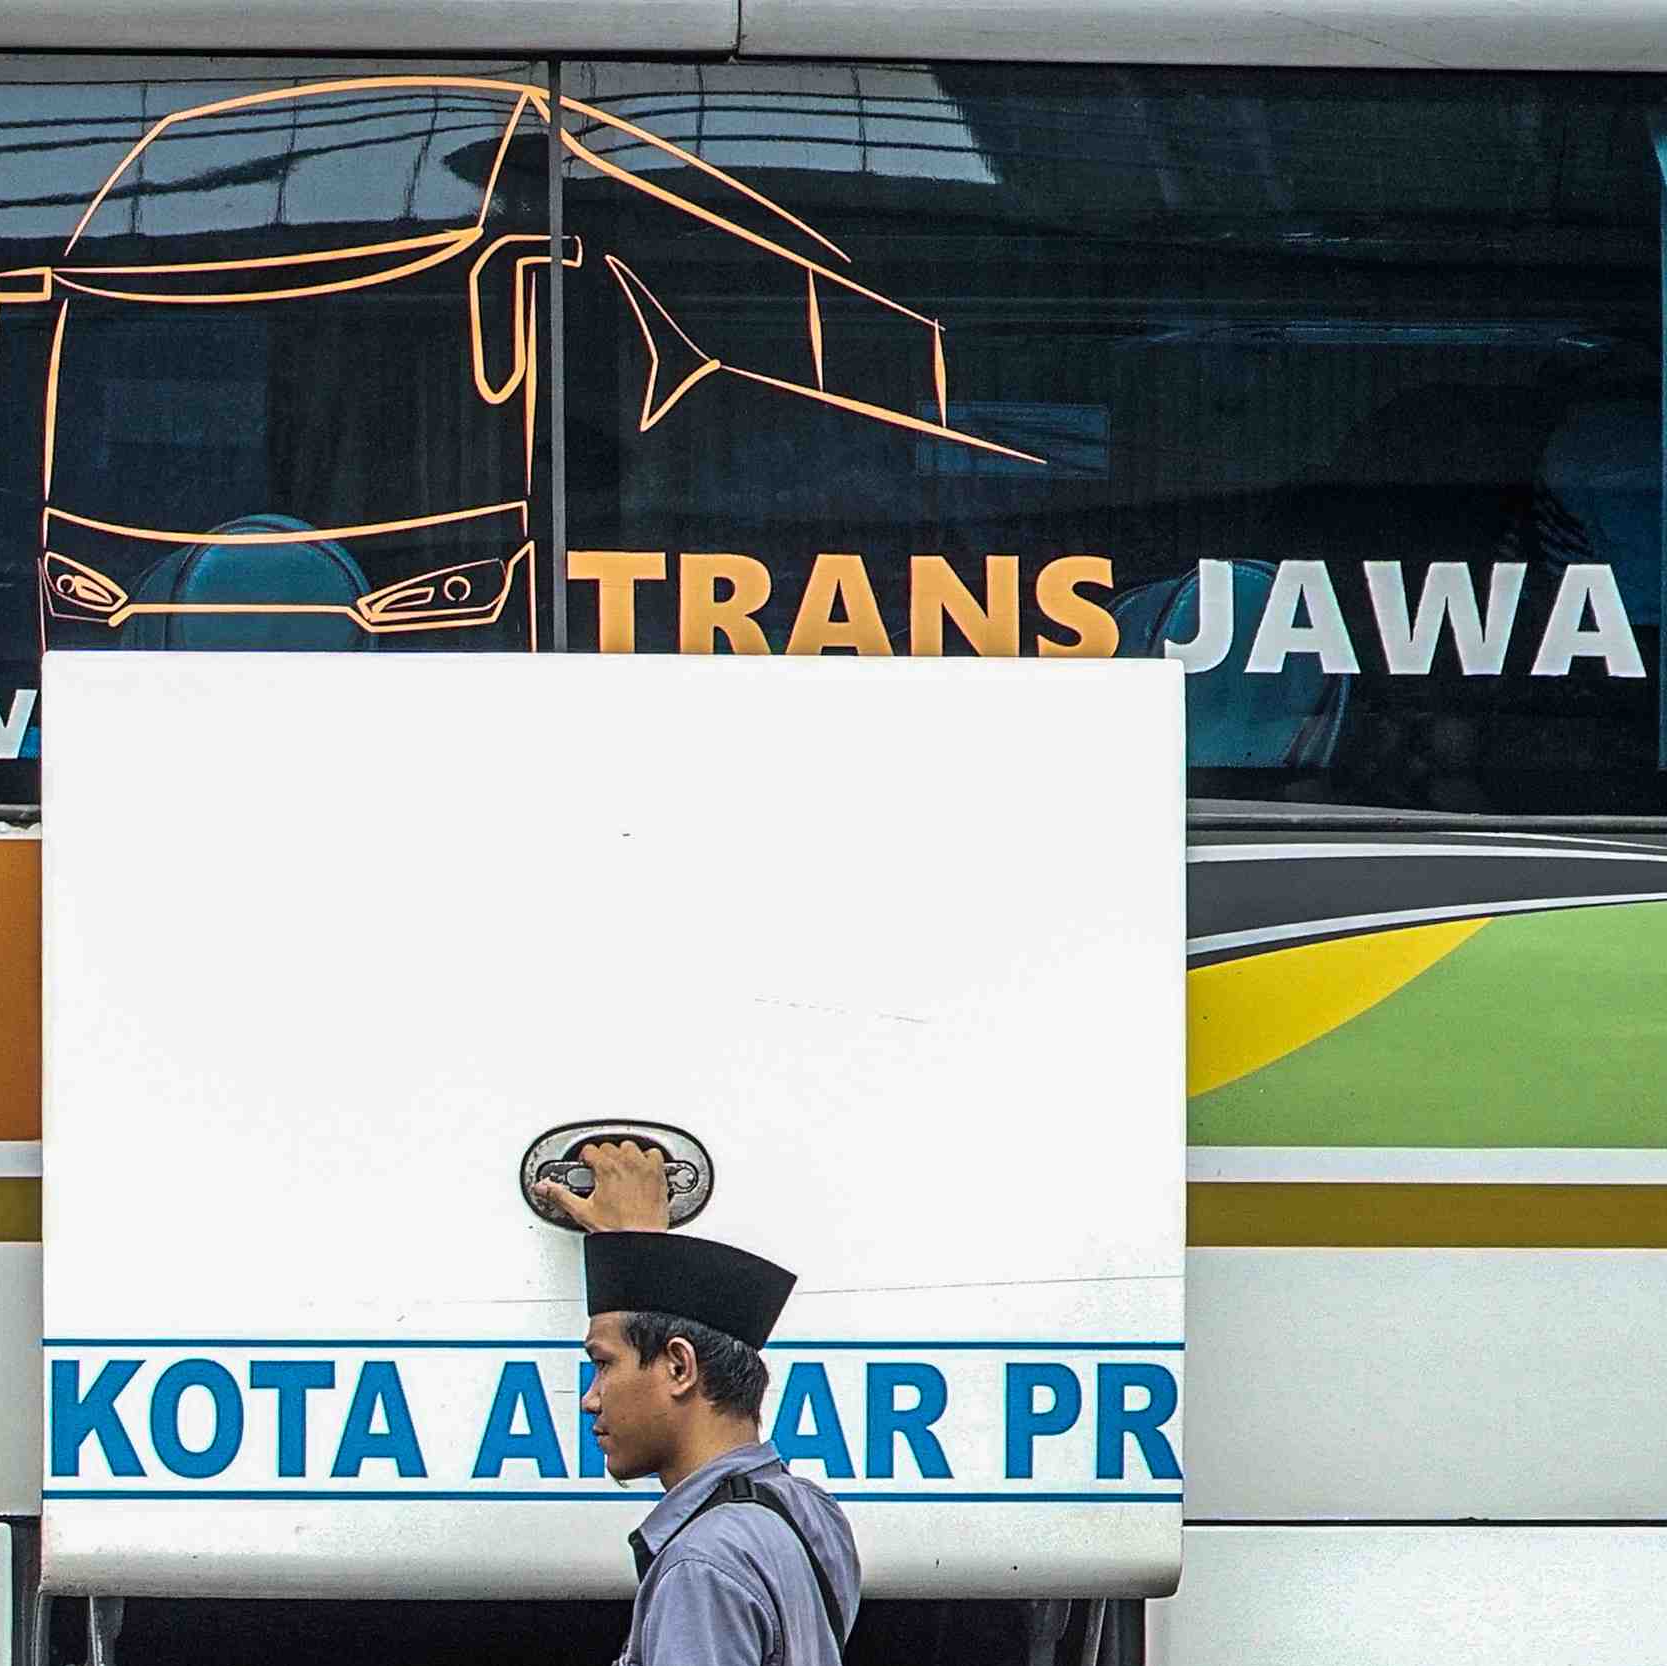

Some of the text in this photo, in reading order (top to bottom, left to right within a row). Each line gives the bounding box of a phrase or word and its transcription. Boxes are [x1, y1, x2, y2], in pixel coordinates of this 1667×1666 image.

[566, 549, 1646, 678] TRANS JAWA
[50, 1356, 1184, 1482] KOTA AAR PR
